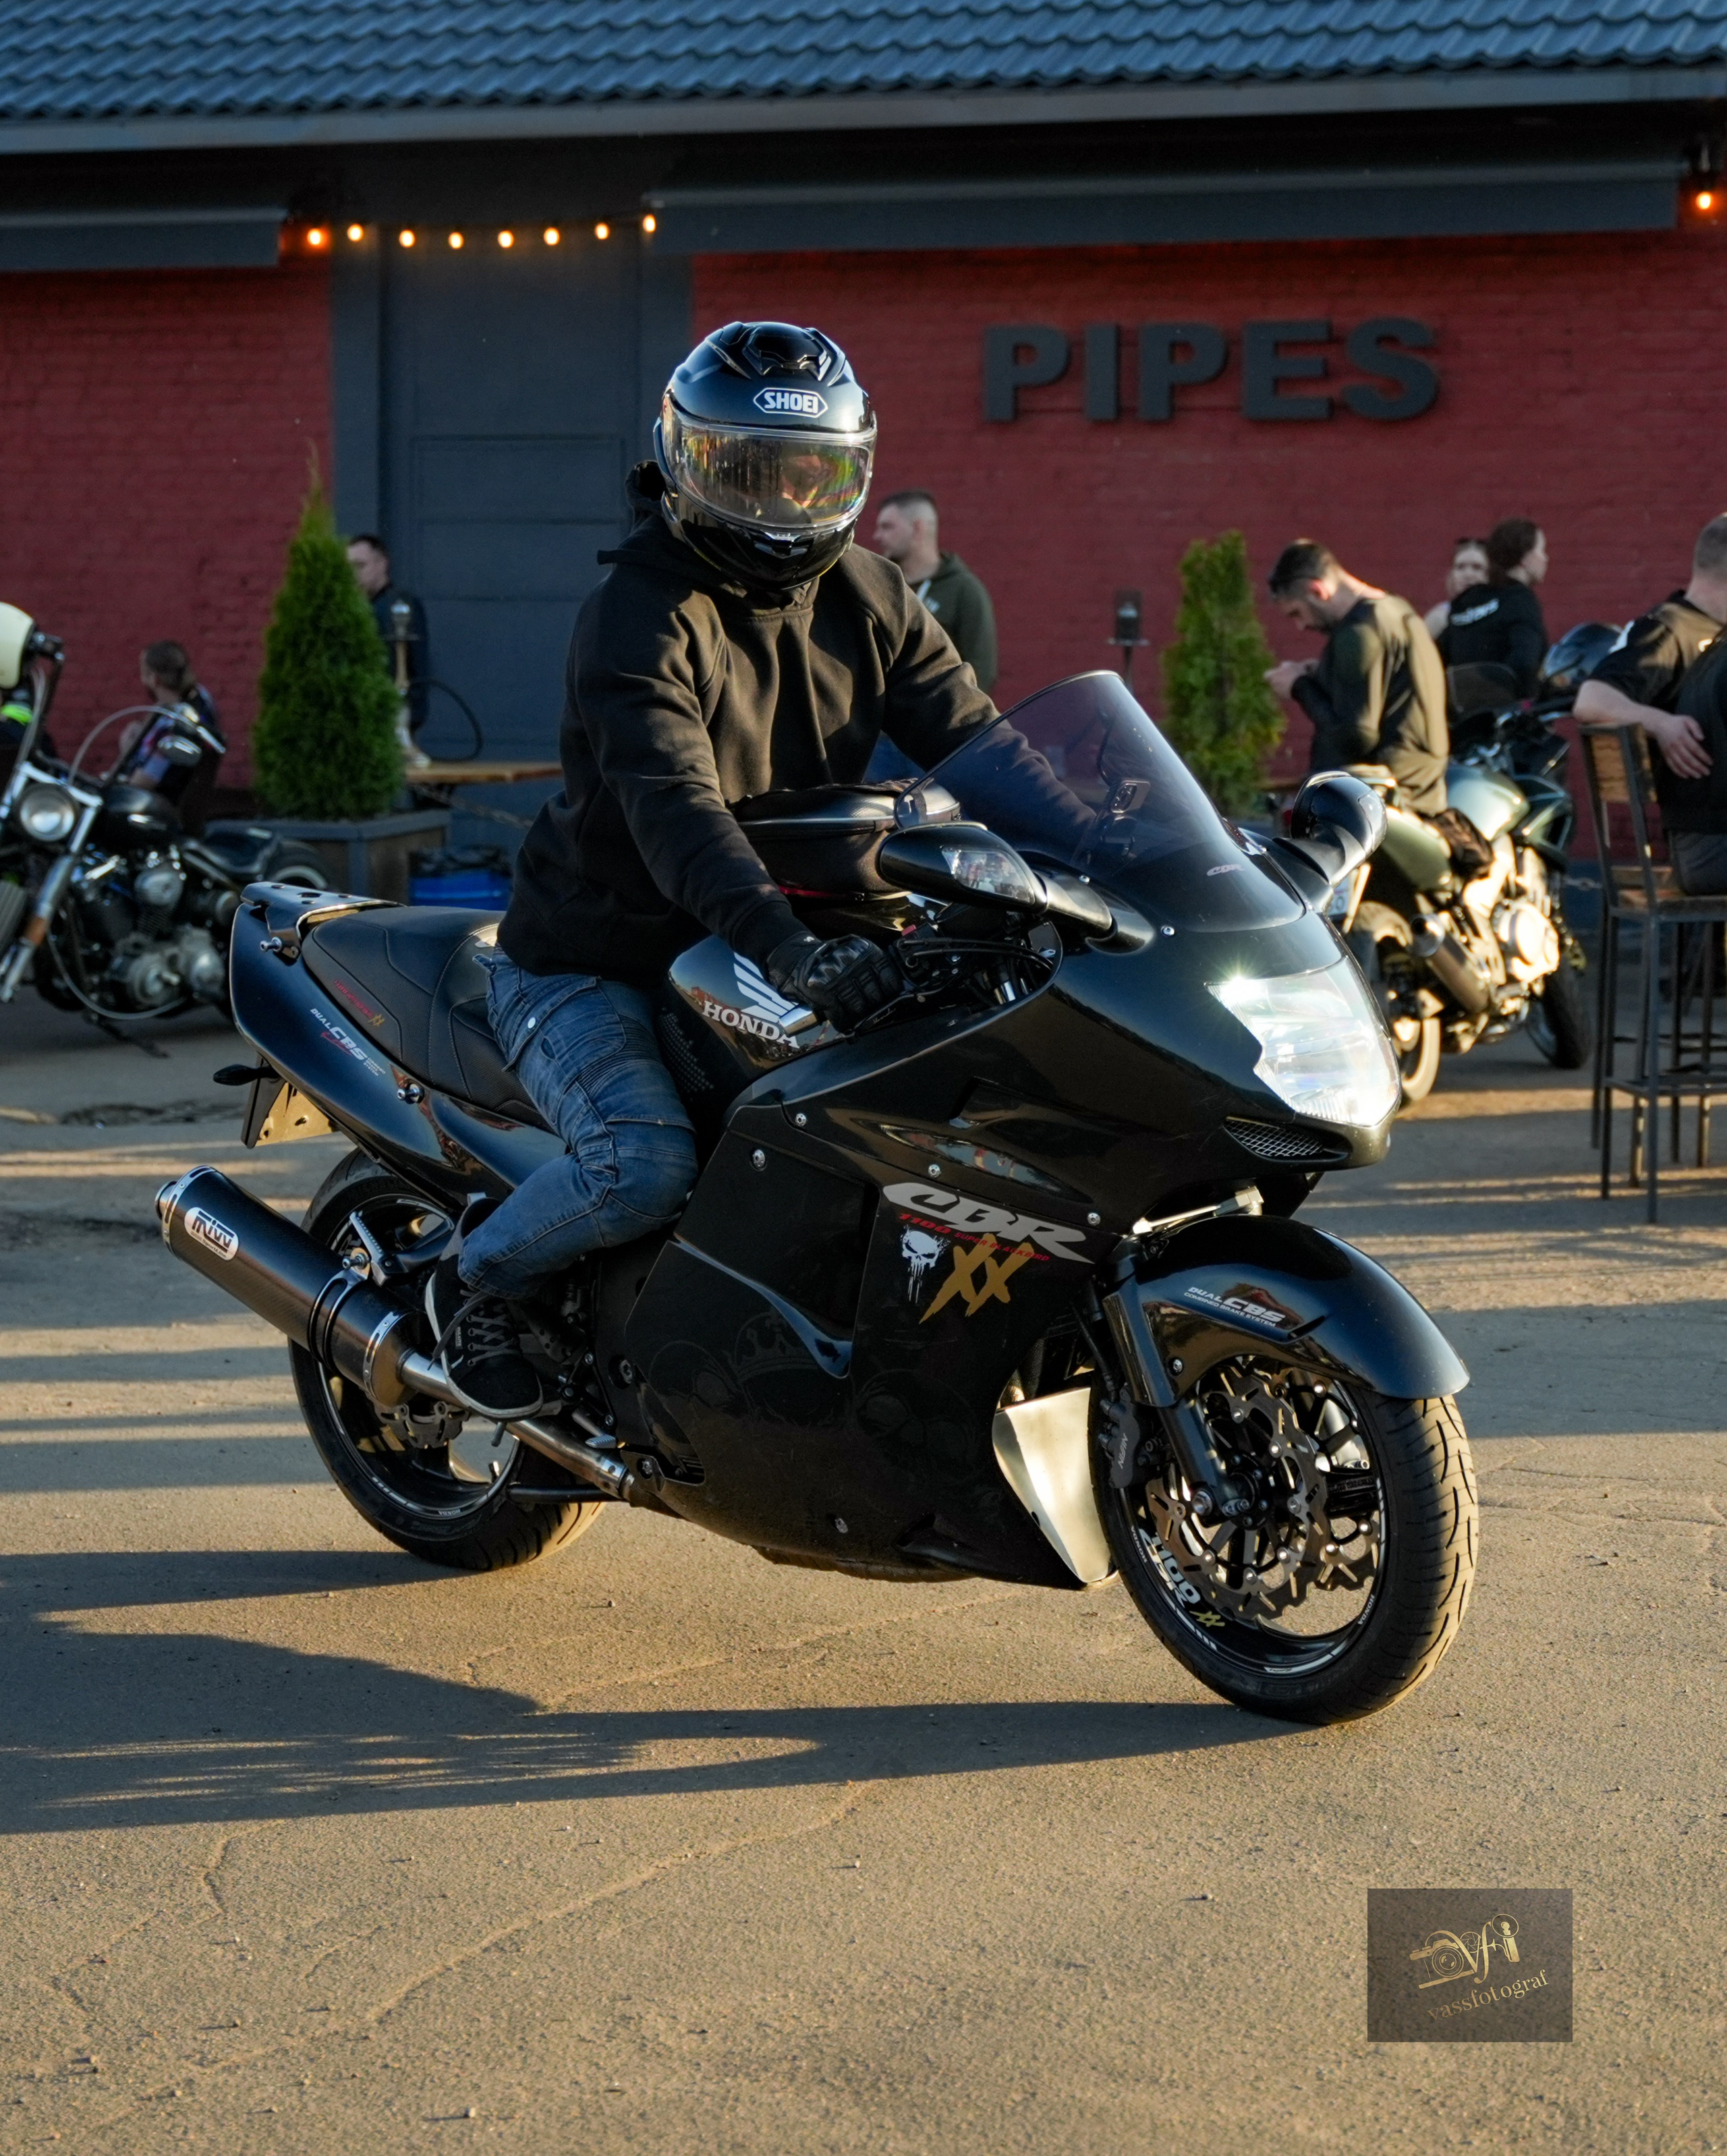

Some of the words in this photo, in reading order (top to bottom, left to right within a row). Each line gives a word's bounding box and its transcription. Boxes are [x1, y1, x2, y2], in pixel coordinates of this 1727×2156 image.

[984, 318, 1439, 422] PIPES
[764, 392, 818, 414] SHOEI
[310, 1008, 331, 1030] DUAL
[329, 1026, 368, 1060] CBS
[702, 1000, 800, 1049] HONDA
[882, 1182, 1096, 1264] CBR
[899, 1214, 952, 1235] 1100
[954, 1232, 988, 1246] SUPER
[989, 1243, 1050, 1261] BLACKBIRD
[918, 1232, 1036, 1324] XX
[1183, 1292, 1219, 1307] COMBINED
[1220, 1304, 1245, 1317] BRAKE
[1247, 1313, 1276, 1328] SYSTEM
[1187, 1286, 1222, 1303] DUAL
[1223, 1297, 1286, 1322] CBS
[1130, 1525, 1148, 1564] HONDA
[1357, 1594, 1376, 1626] HONDA
